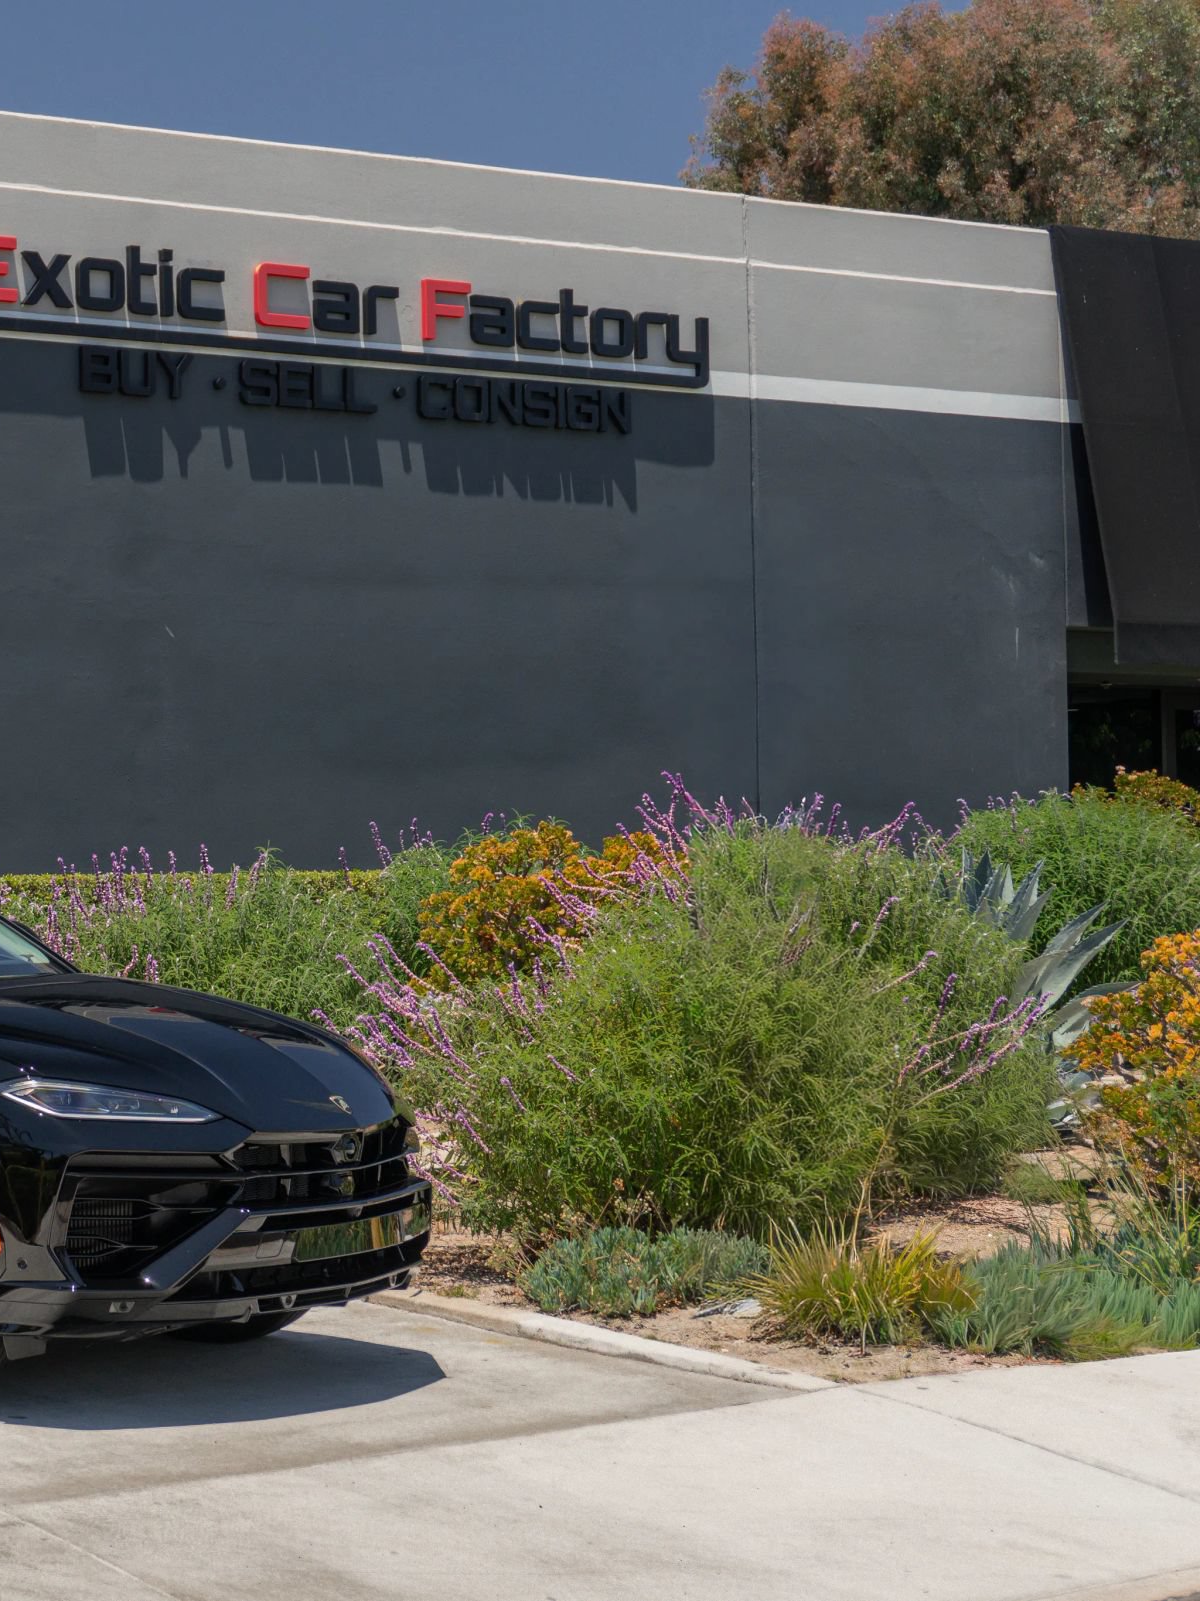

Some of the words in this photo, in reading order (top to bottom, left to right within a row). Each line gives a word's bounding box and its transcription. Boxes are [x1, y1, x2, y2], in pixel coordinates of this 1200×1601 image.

[253, 262, 400, 335] Car
[420, 278, 710, 388] Factory
[78, 345, 193, 399] BUY
[239, 359, 378, 414] SELL
[416, 374, 632, 435] CONSIGN
